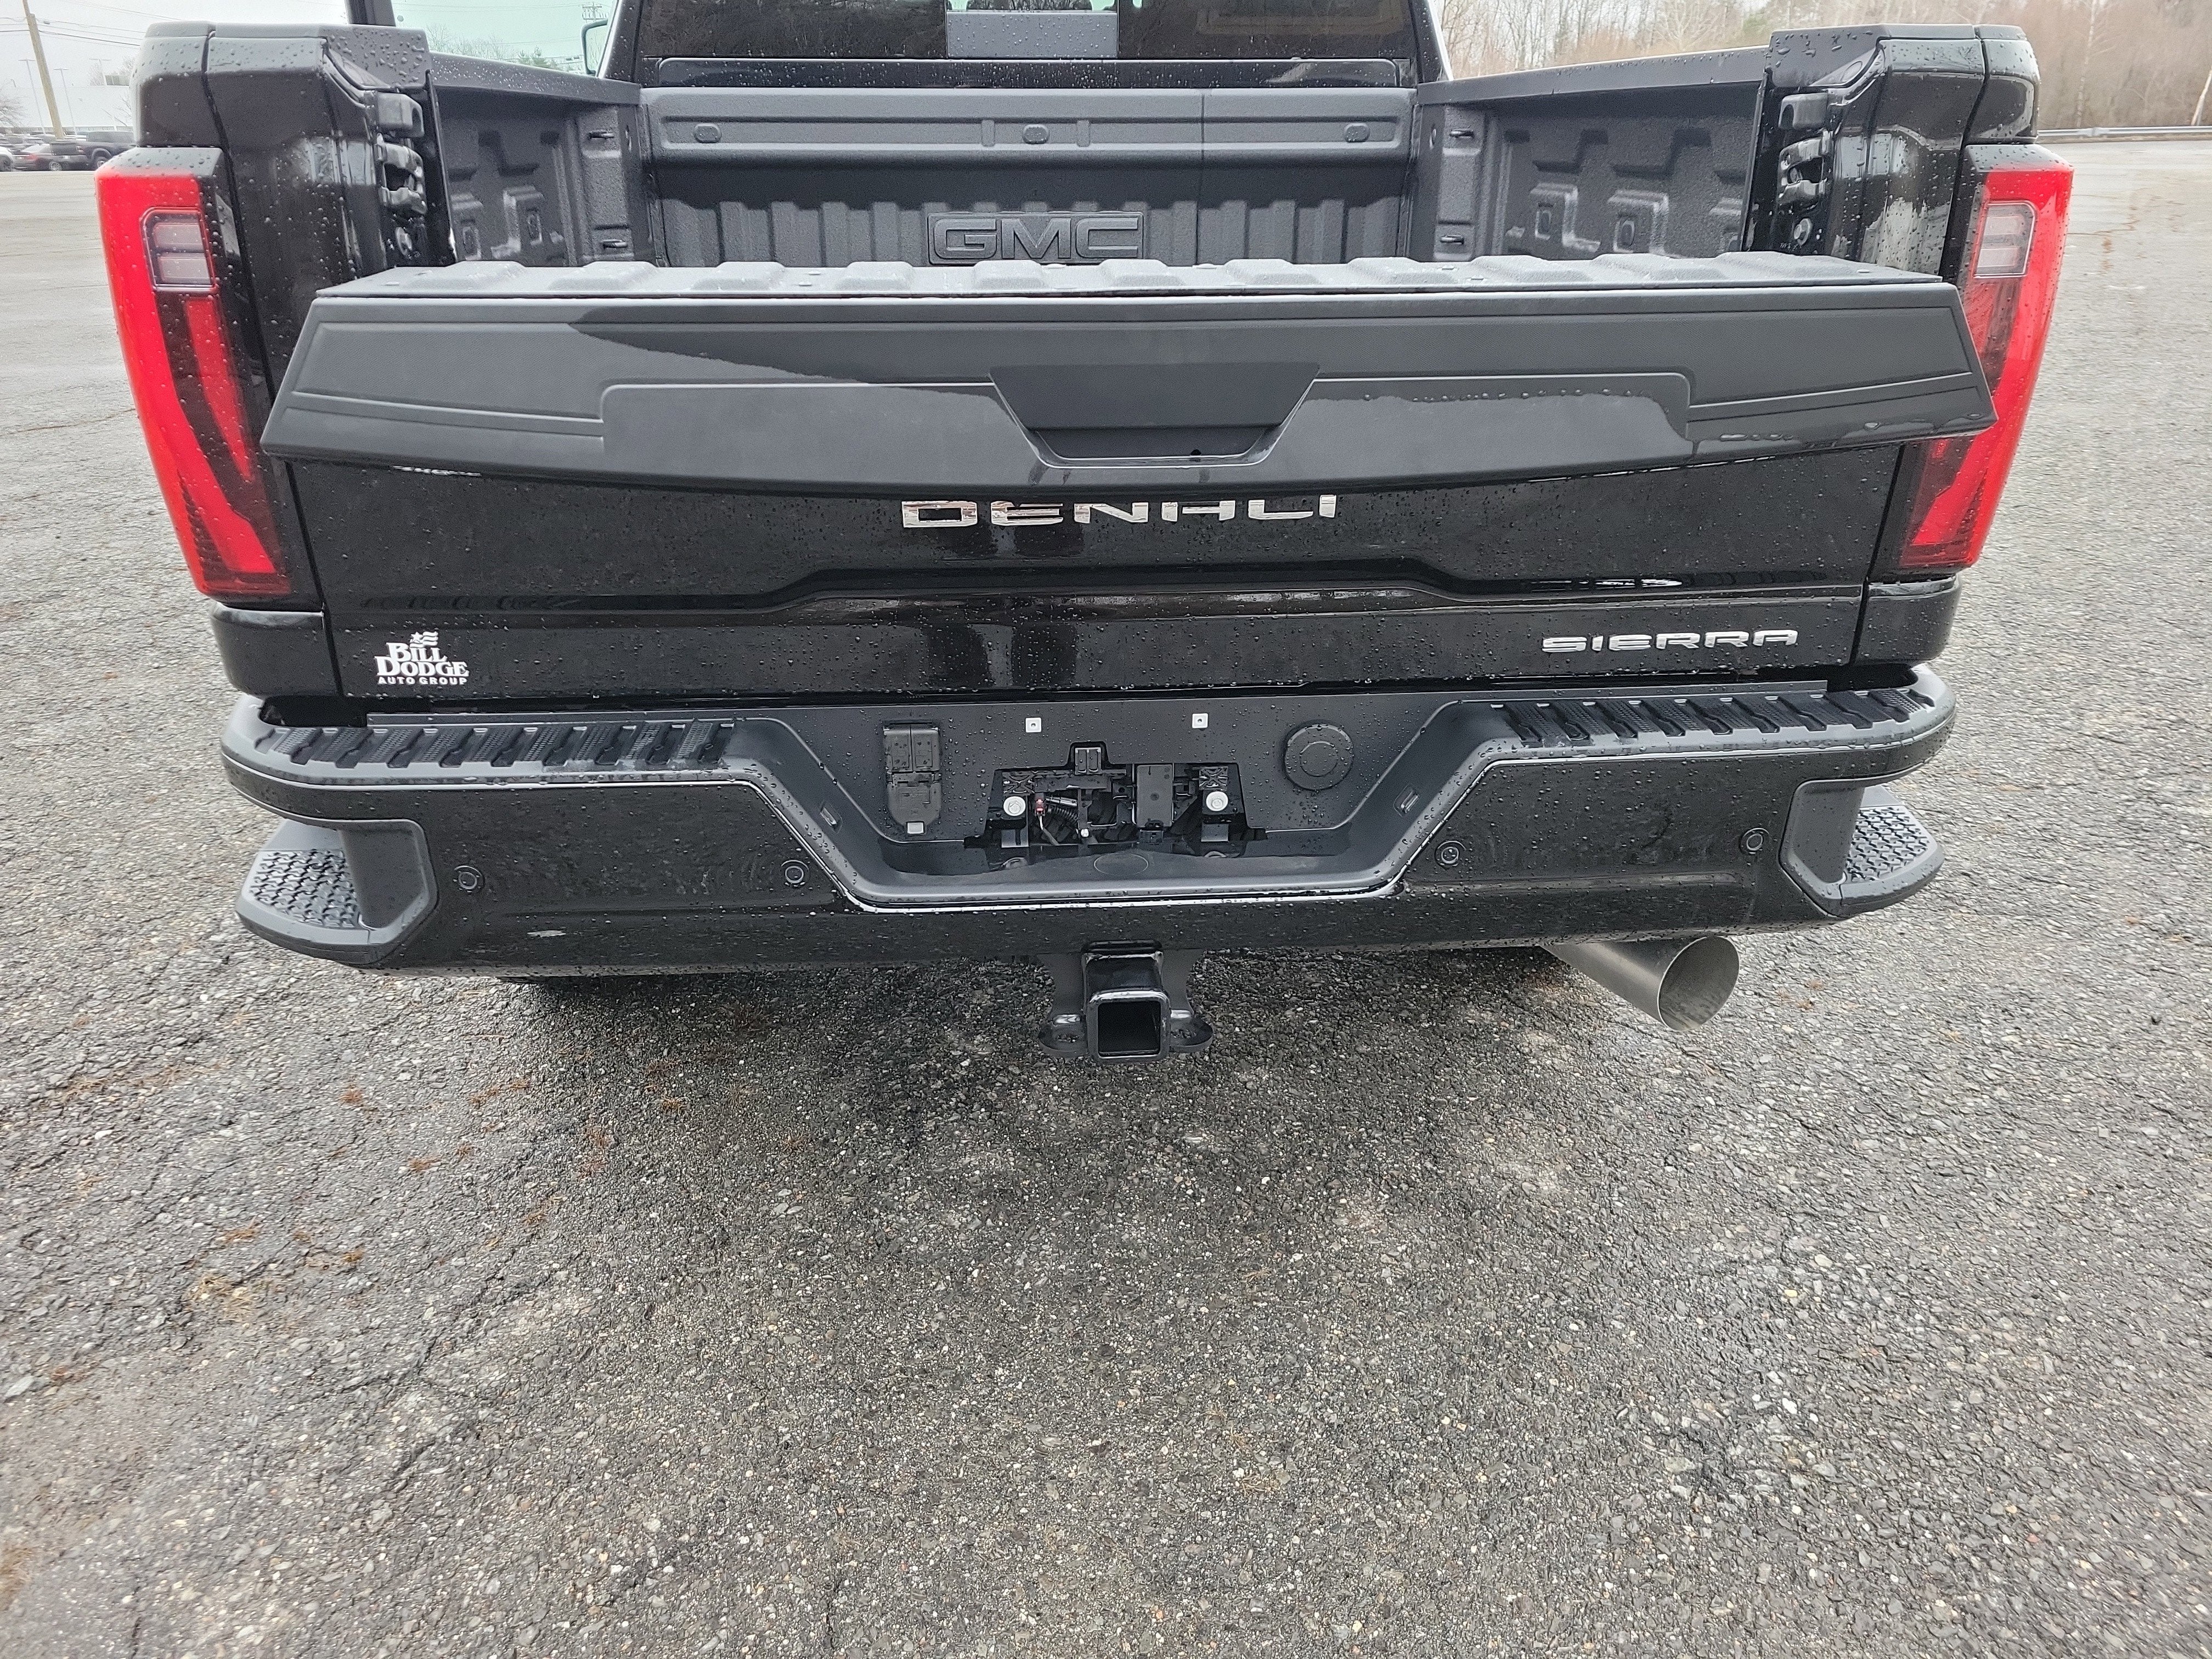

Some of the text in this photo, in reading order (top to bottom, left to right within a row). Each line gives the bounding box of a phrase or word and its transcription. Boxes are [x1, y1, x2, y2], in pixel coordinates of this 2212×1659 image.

[934, 218, 1138, 259] GMC
[901, 494, 1337, 528] DENALI
[1541, 629, 1798, 653] SIERRA
[386, 642, 448, 663] BILL
[374, 656, 470, 677] DODGE
[378, 676, 467, 685] AUTO GROUP
